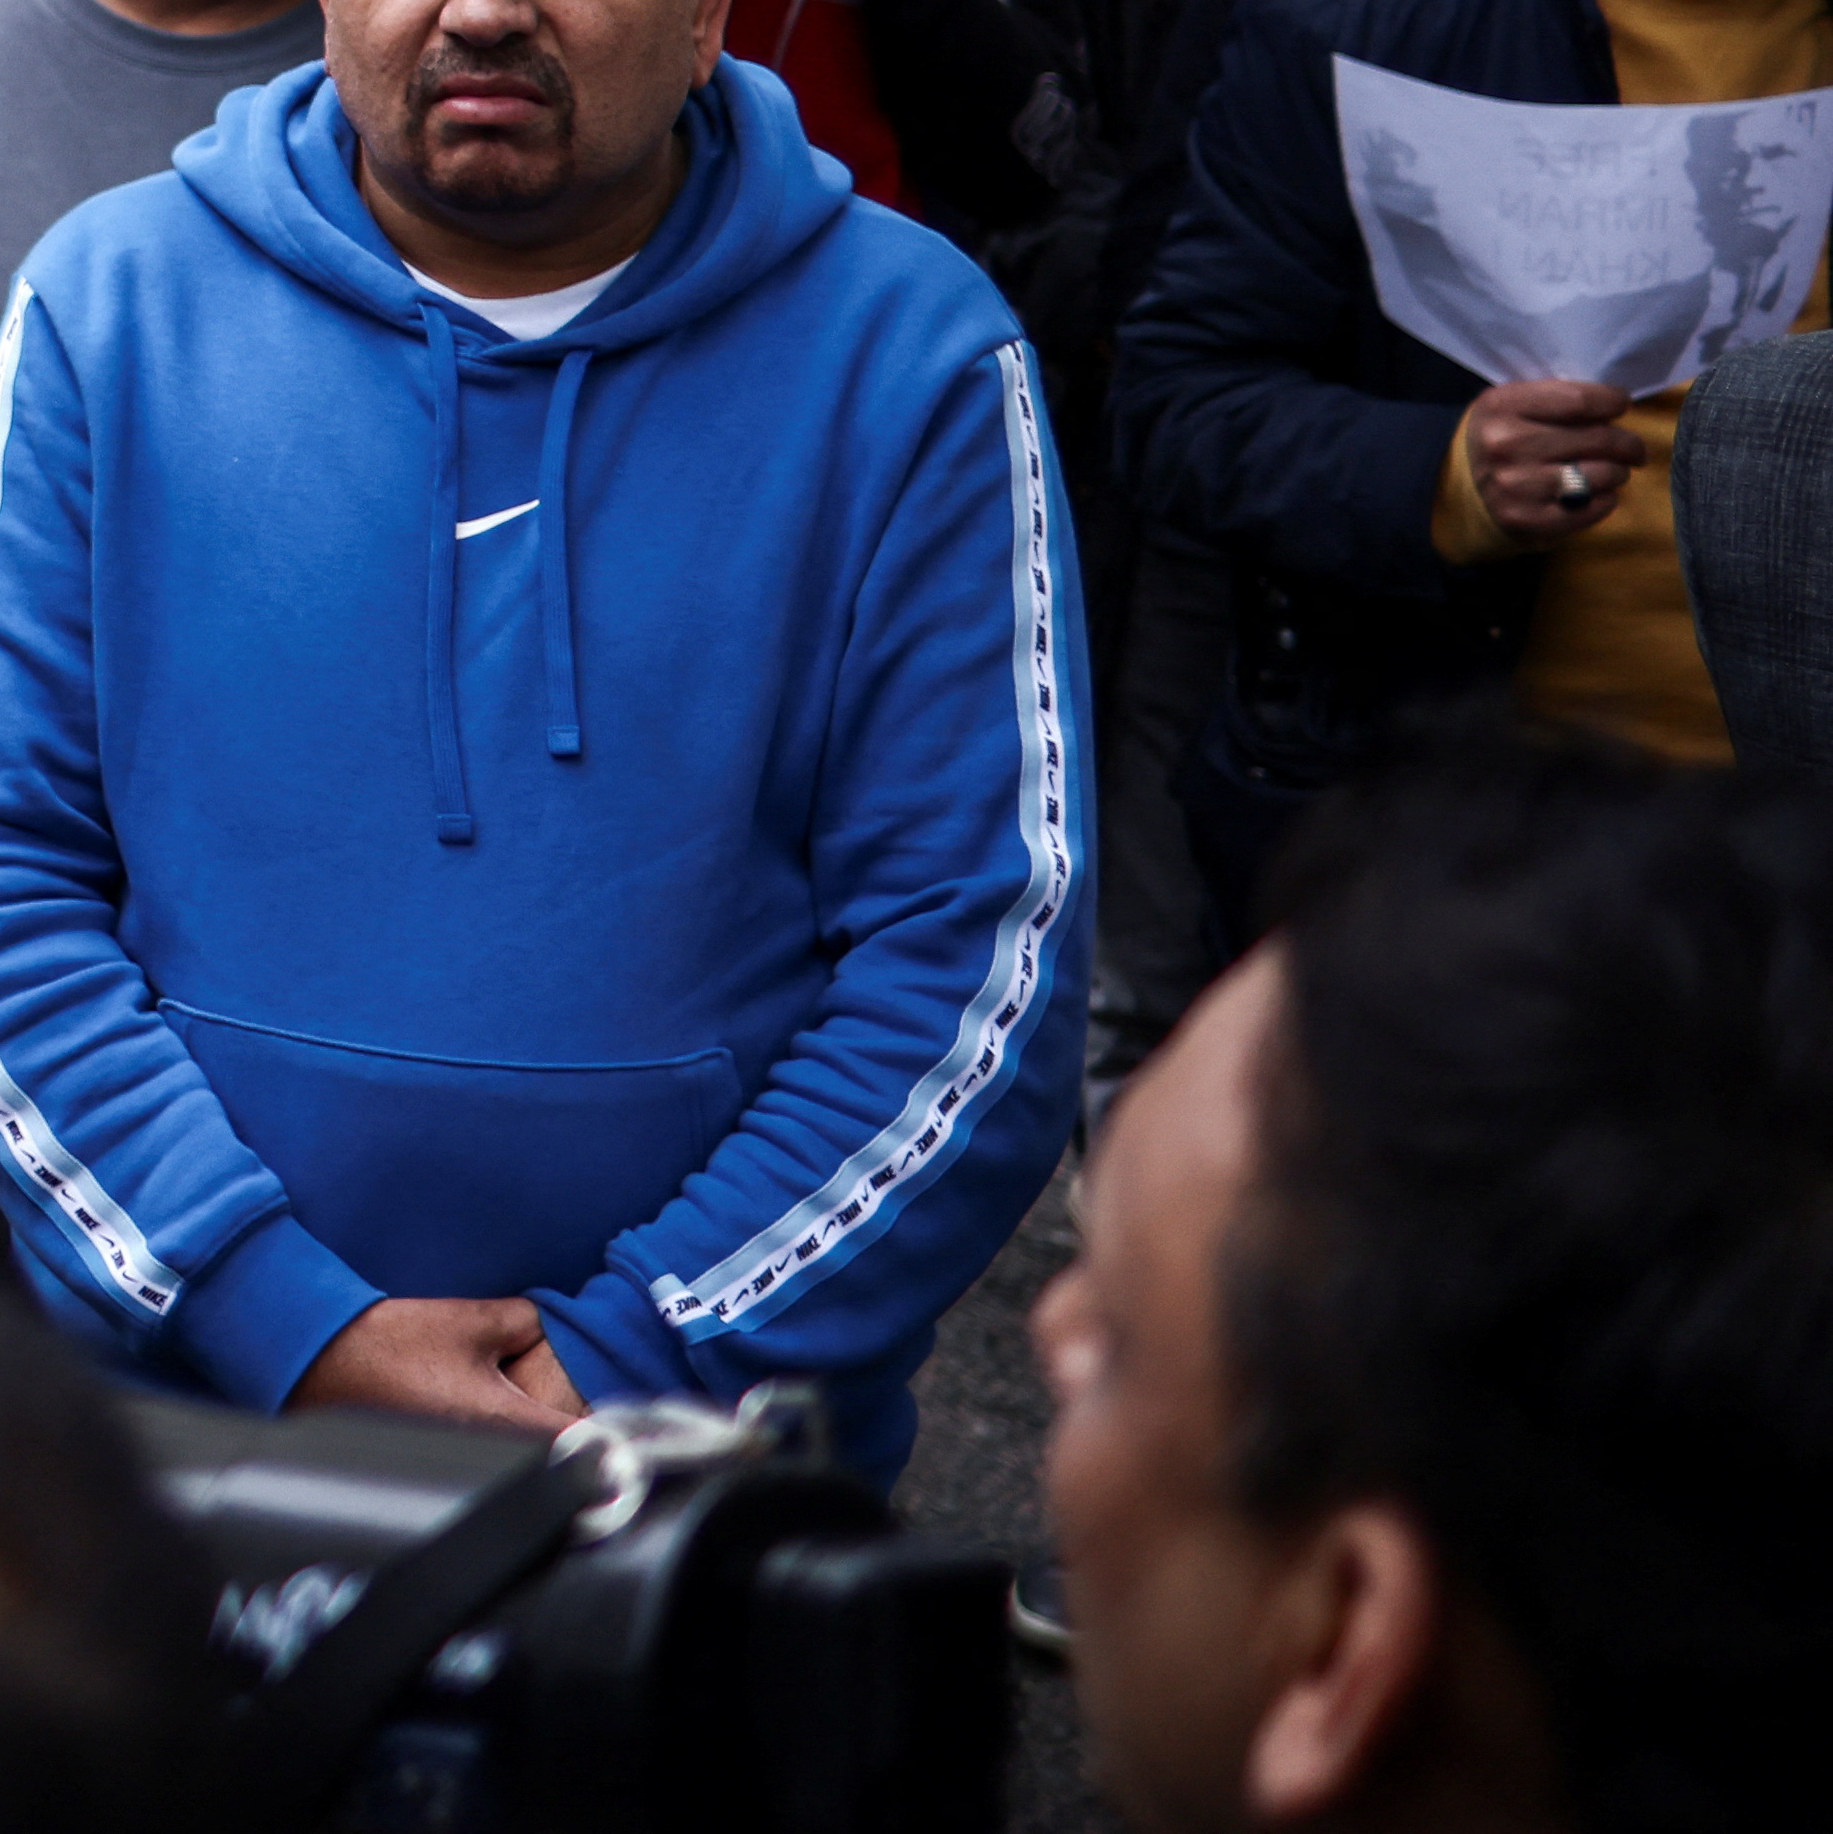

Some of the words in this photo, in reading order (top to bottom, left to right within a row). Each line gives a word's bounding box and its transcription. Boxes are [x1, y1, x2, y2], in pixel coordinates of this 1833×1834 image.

[995, 1001, 1019, 1030] NIKE
[937, 1086, 960, 1117] NIKE
[914, 1125, 938, 1156] NIKE
[869, 1165, 897, 1191] NIKE
[836, 1199, 862, 1226] NIKE
[75, 1208, 101, 1230] NIKE
[138, 1286, 168, 1307] NIKE
[795, 1234, 821, 1261] NIKE
[752, 1266, 775, 1295] NIKE
[675, 1296, 702, 1315] NIKE
